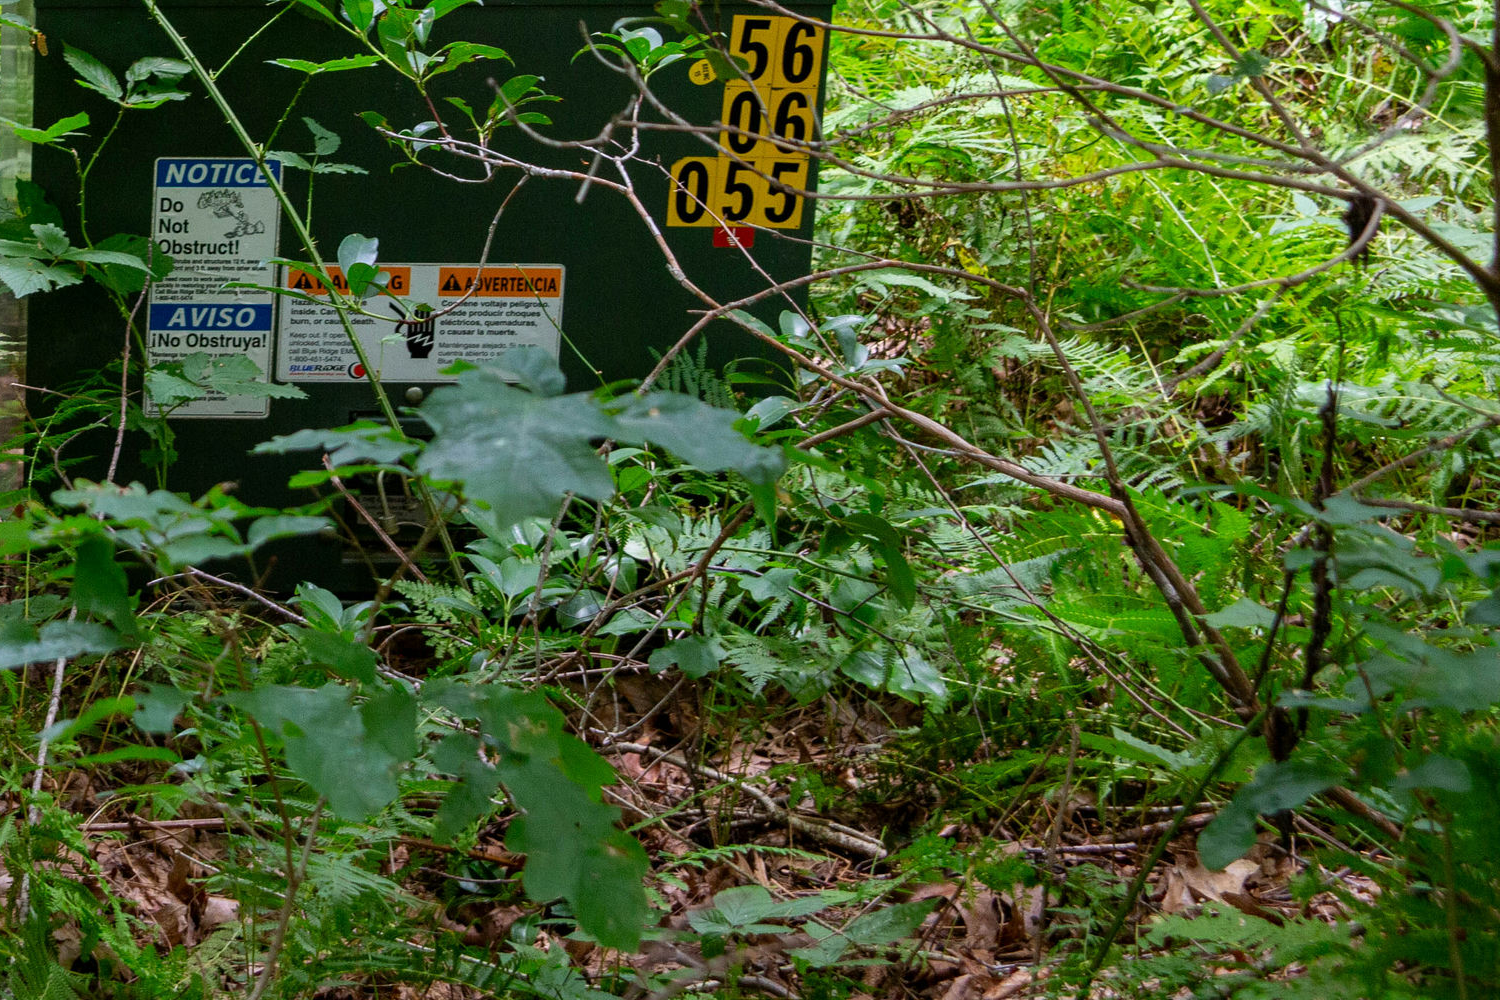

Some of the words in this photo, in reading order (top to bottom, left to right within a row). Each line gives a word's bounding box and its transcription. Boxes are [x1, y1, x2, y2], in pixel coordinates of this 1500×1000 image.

[738, 19, 816, 84] 56
[727, 90, 808, 154] 06
[165, 163, 273, 184] NOTICE
[675, 161, 800, 224] 055
[160, 198, 184, 212] Do
[158, 218, 189, 234] Not
[158, 240, 239, 255] Obstruct!
[464, 277, 557, 292] ADVERTENCIA
[480, 300, 507, 308] voltaje
[167, 308, 256, 327] AVISO
[468, 310, 503, 318] producir
[506, 310, 541, 318] choques
[484, 319, 538, 327] quemaduras,
[151, 333, 180, 348] ¡No
[186, 333, 266, 351] Obstruya!
